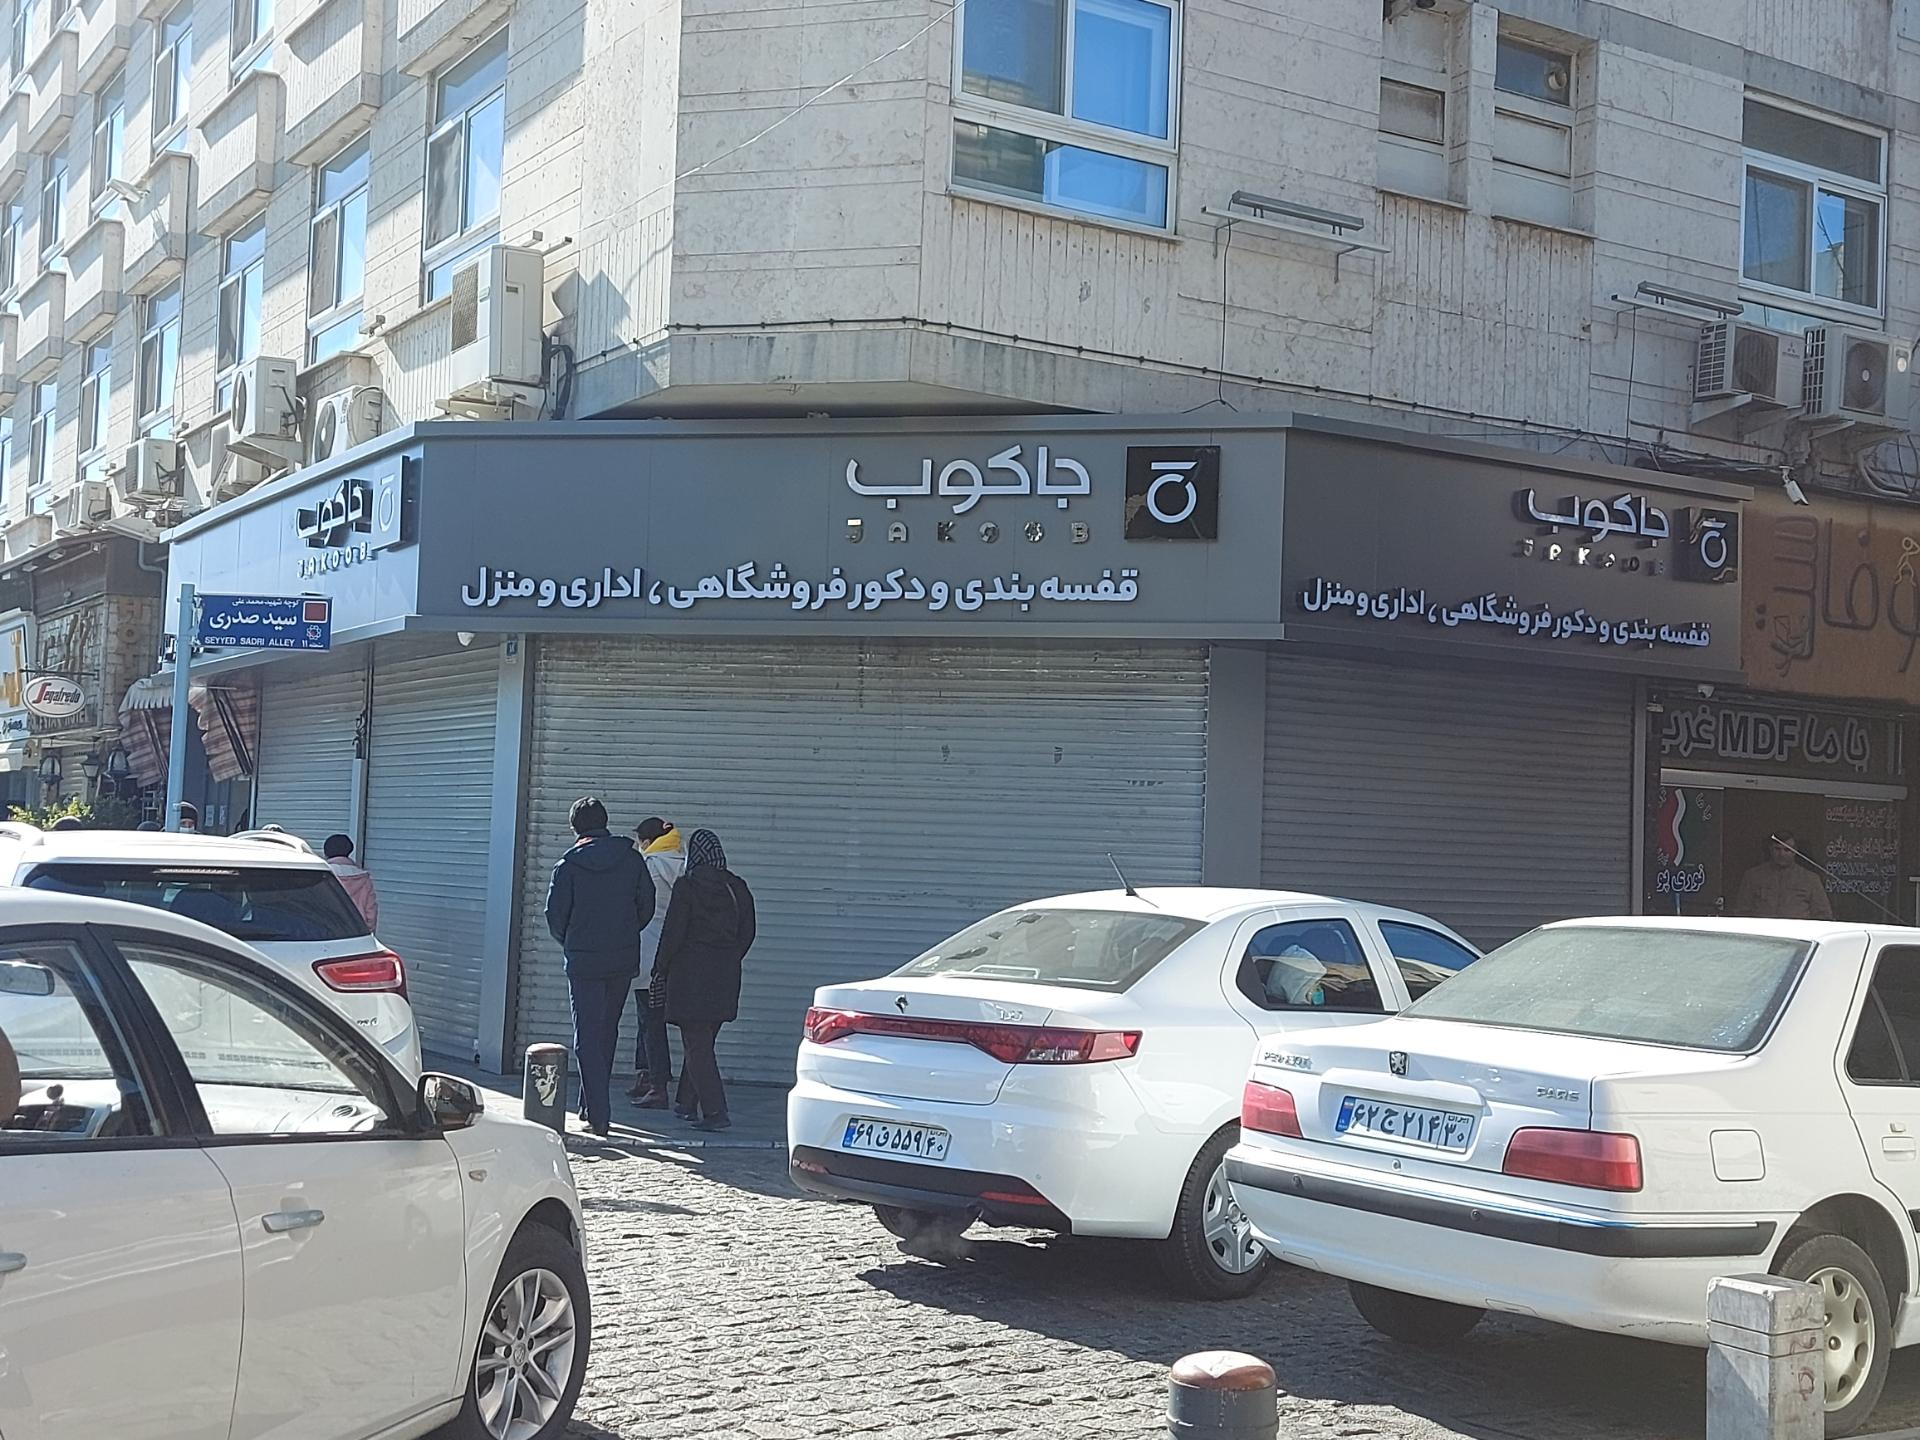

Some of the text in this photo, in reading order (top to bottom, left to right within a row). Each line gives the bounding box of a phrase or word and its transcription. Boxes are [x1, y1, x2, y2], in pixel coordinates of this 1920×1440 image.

[846, 444, 1091, 515] جاکوب
[296, 479, 364, 547] جاکوب
[1527, 488, 1669, 549] جاکوب
[845, 519, 1090, 544] JAKOOB
[297, 541, 368, 579] JAKOOB
[461, 566, 536, 607] منزل
[537, 578, 556, 607] و
[560, 567, 641, 608] اداری
[667, 562, 847, 610] فروشگاهی
[847, 568, 926, 610] دکور
[928, 580, 949, 611] و
[954, 573, 1035, 611] بندی
[1040, 569, 1139, 601] قفسه
[1303, 577, 1356, 611] منزل
[264, 598, 283, 607] شهید
[283, 599, 300, 607] کوچه
[1371, 588, 1425, 620] اداری
[1442, 593, 1552, 635] فروشگاهی
[209, 610, 298, 630] سید صدری
[1552, 609, 1597, 639] دکور
[1613, 619, 1656, 649] بندی
[1659, 623, 1711, 647] قفسه
[205, 636, 295, 647] SEYYED SADRI ALLEY
[32, 682, 81, 703] Segafredo
[1718, 709, 1799, 762] MDF
[1536, 1086, 1580, 1102] PARS
